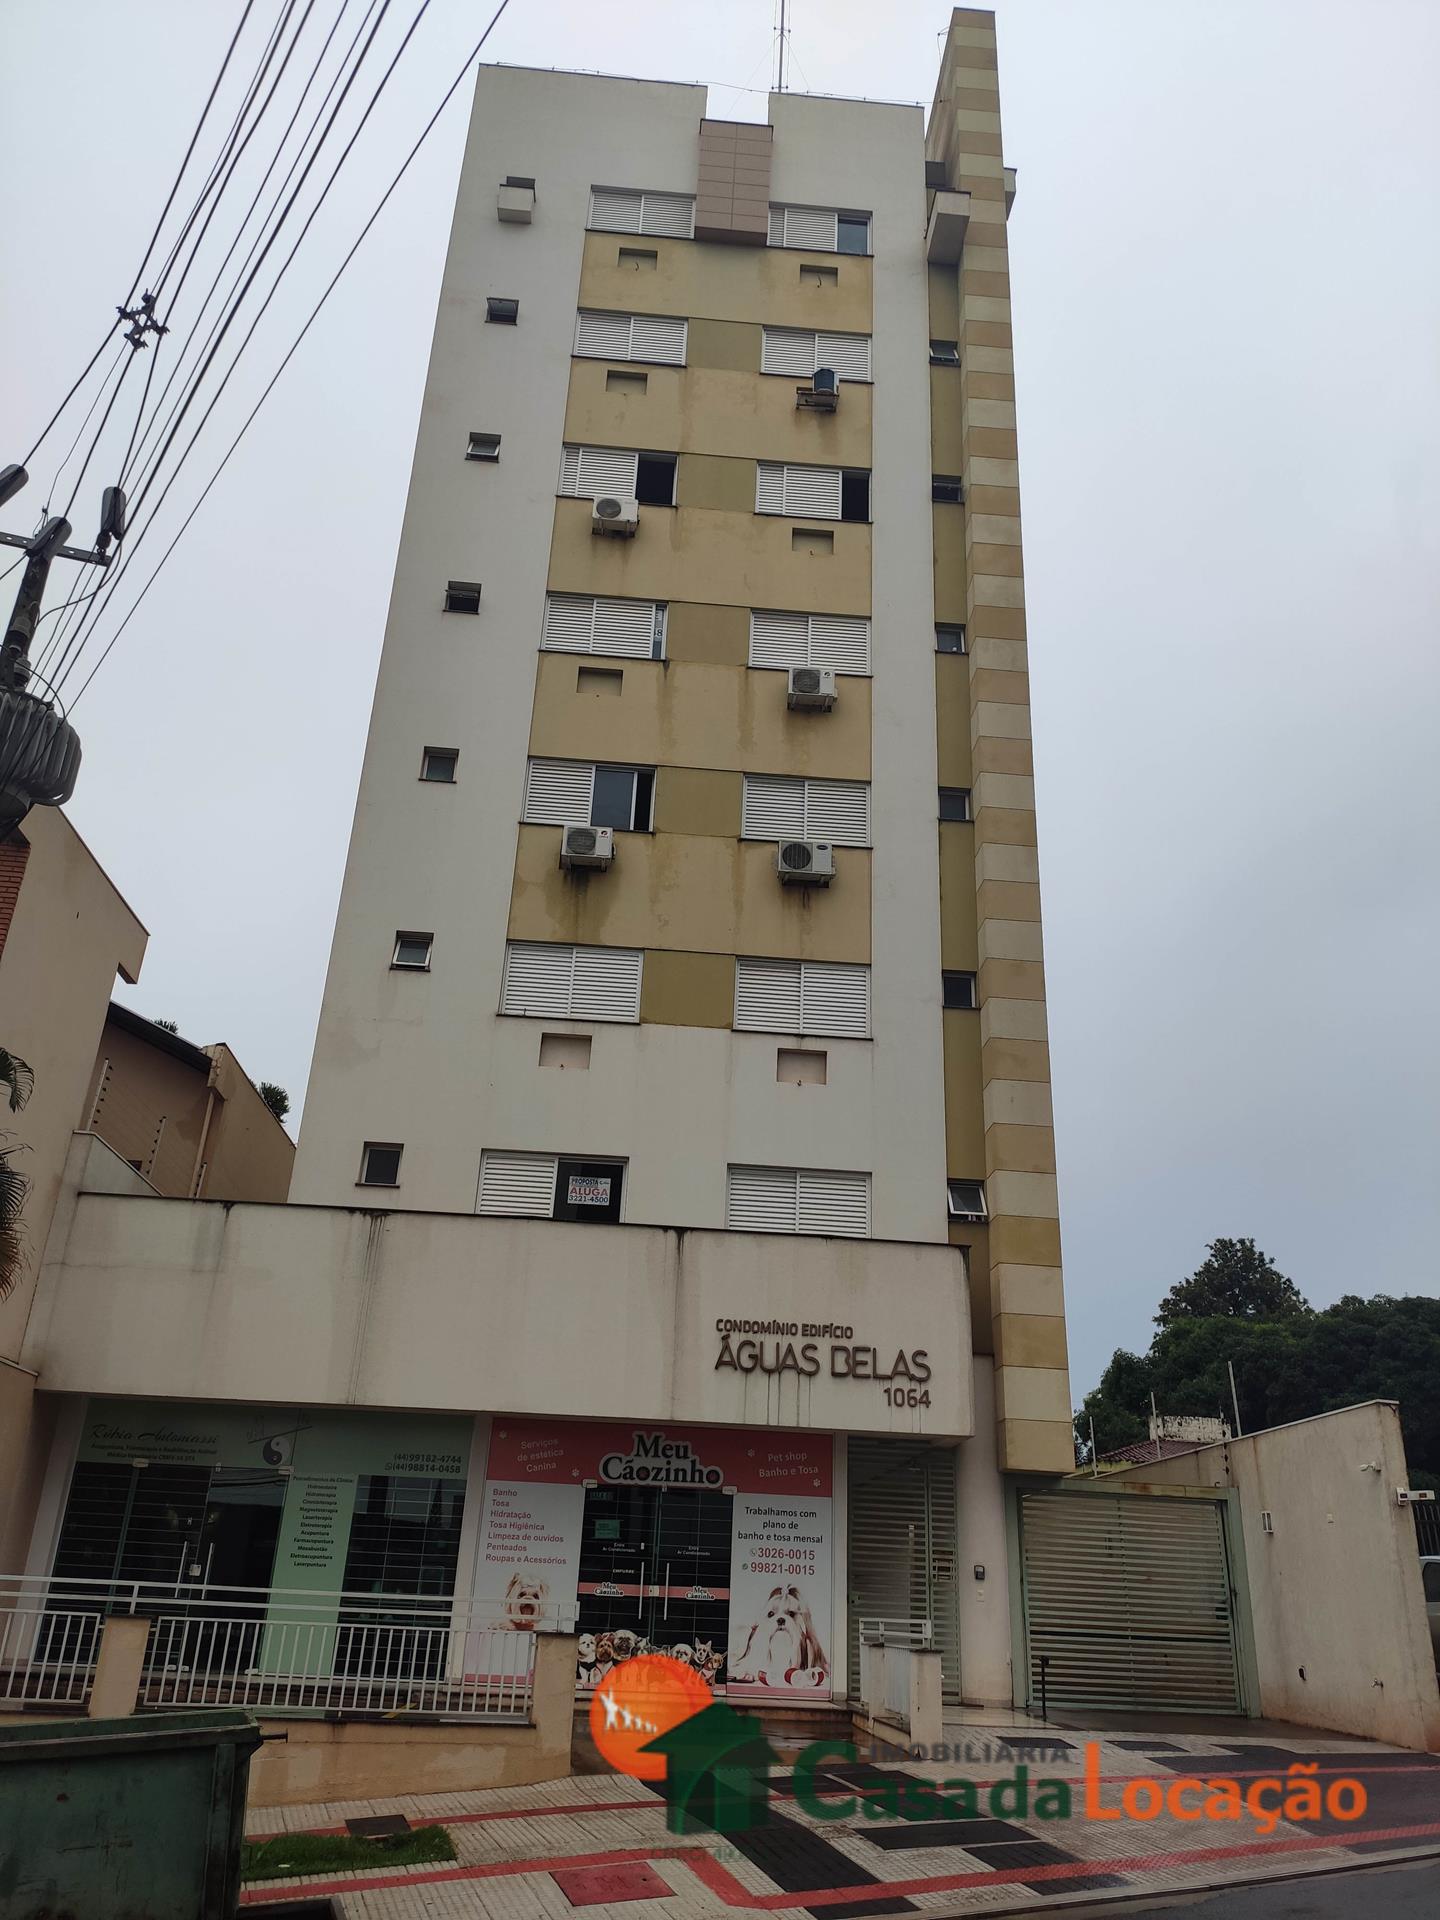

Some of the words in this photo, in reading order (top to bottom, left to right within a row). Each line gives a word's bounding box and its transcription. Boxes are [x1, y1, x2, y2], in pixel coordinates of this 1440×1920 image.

[570, 1187, 608, 1196] ALUGA
[716, 1319, 798, 1336] CONDOMÍNIO
[801, 1323, 854, 1339] EDIFÍCIO
[714, 1334, 820, 1376] ÁGUAS
[883, 1387, 931, 1408] 1064
[521, 1438, 559, 1450] Serviços
[634, 1434, 691, 1460] Meu
[517, 1453, 528, 1462] de
[530, 1448, 564, 1460] estética
[768, 1453, 783, 1462] Pet
[785, 1452, 807, 1462] shop
[526, 1462, 557, 1473] Canina
[602, 1456, 721, 1484] Cãozinho
[759, 1467, 788, 1478] Banho
[799, 1466, 819, 1475] Tosa
[493, 1488, 517, 1496] Banho
[491, 1499, 510, 1507] Tosa
[490, 1510, 532, 1520] Hidratação
[745, 1506, 798, 1517] Trabalhamos
[799, 1510, 817, 1518] com
[489, 1521, 508, 1529] Tosa
[509, 1521, 545, 1532] Higiênica
[762, 1520, 786, 1530] plano
[788, 1521, 799, 1529] de
[488, 1532, 520, 1542] Limpeza
[522, 1533, 532, 1541] de
[533, 1534, 565, 1543] ouvidos
[738, 1531, 764, 1541] banho
[773, 1534, 791, 1542] tosa
[793, 1535, 823, 1544] mensal
[486, 1543, 528, 1552] Penteados
[757, 1547, 815, 1560] 3026-0015
[485, 1553, 515, 1563] Roupas
[523, 1555, 567, 1565] Acessórios
[750, 1562, 815, 1576] 99821-0015
